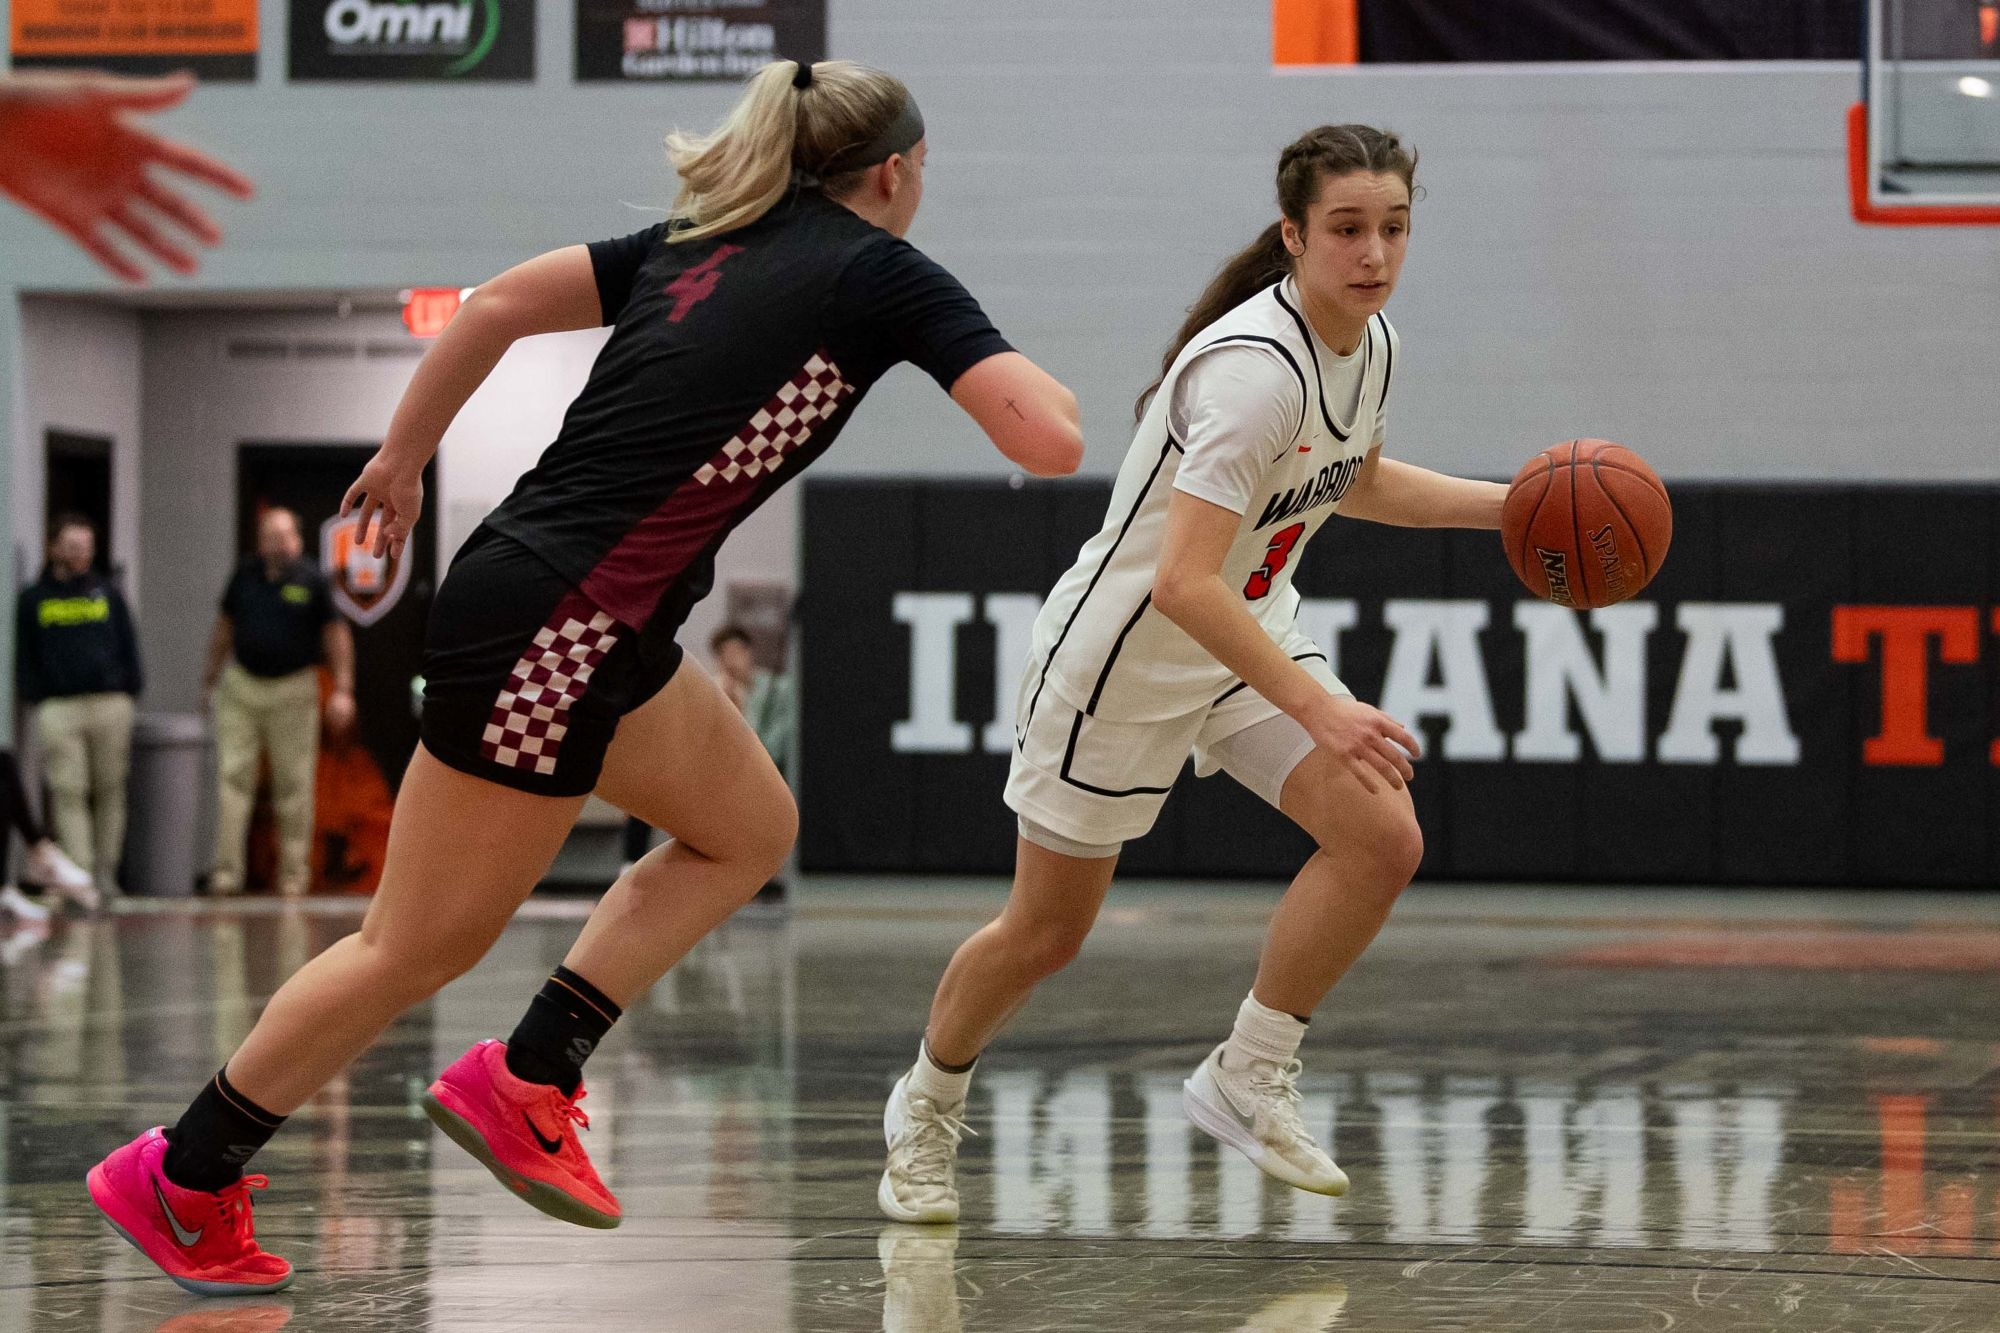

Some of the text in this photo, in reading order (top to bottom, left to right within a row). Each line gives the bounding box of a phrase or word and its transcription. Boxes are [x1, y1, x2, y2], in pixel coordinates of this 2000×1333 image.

[323, 0, 473, 44] Omni
[663, 243, 746, 324] 4
[1242, 521, 1306, 601] 3
[890, 591, 2000, 767] IANA T
